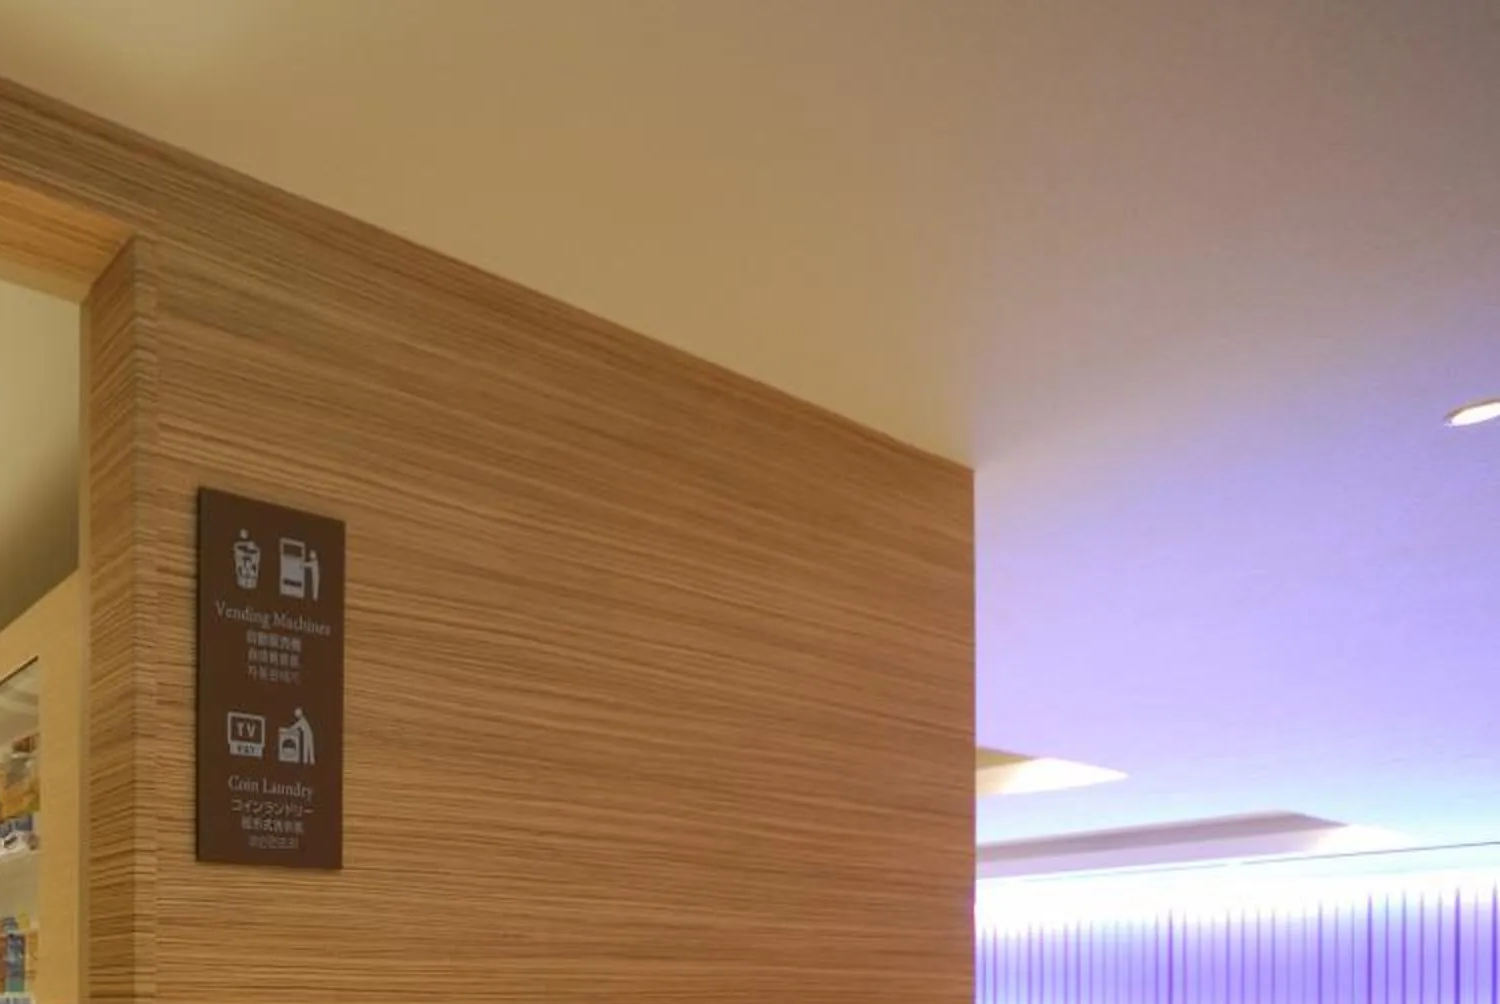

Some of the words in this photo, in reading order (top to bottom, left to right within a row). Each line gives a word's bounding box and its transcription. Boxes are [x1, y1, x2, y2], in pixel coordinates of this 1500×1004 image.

[214, 600, 271, 629] Vending
[273, 611, 332, 637] Machines
[235, 722, 256, 737] TV
[228, 775, 259, 793] Coin
[262, 777, 314, 803] Laundry
[231, 798, 314, 818] コインランドリー
